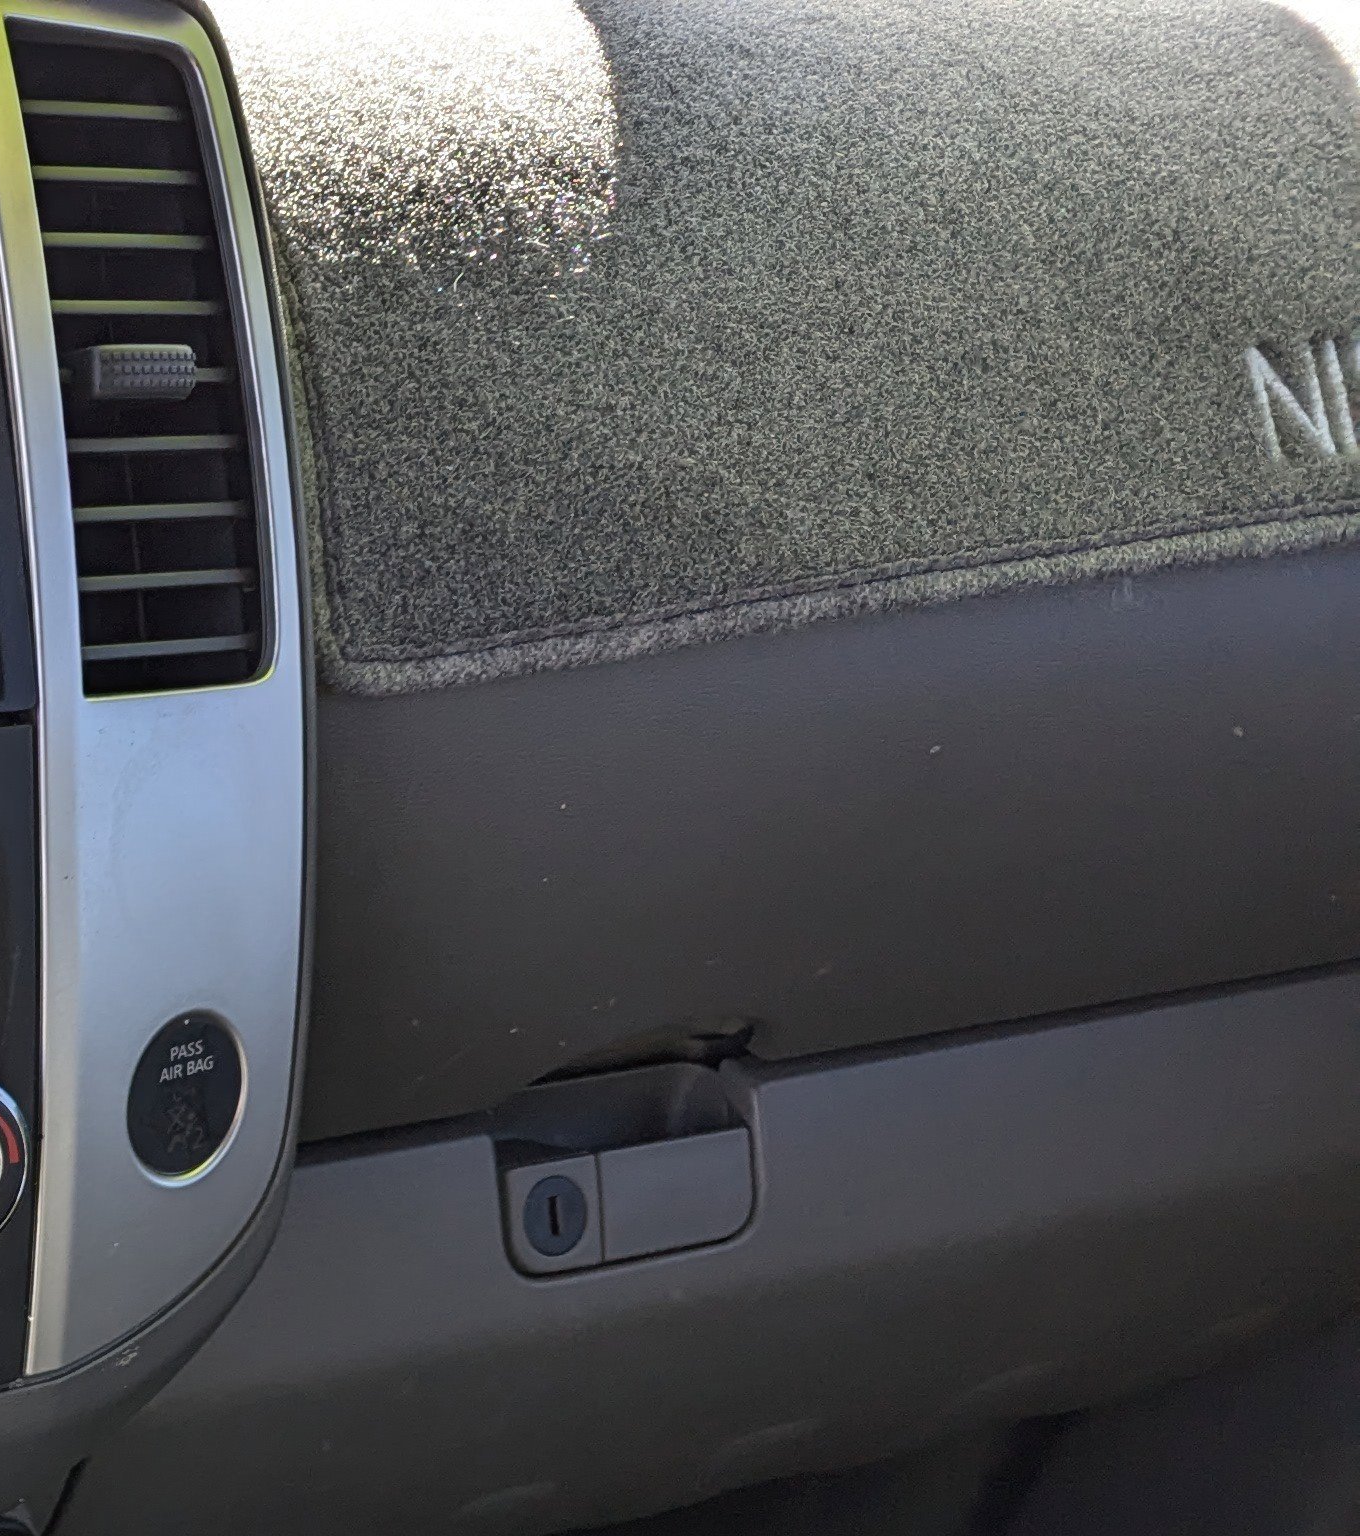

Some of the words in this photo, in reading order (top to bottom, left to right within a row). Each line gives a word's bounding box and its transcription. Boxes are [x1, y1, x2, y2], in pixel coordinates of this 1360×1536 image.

[1245, 339, 1360, 463] NI
[169, 1038, 204, 1062] PASS
[159, 1064, 183, 1083] AIR
[187, 1055, 214, 1076] BAG
